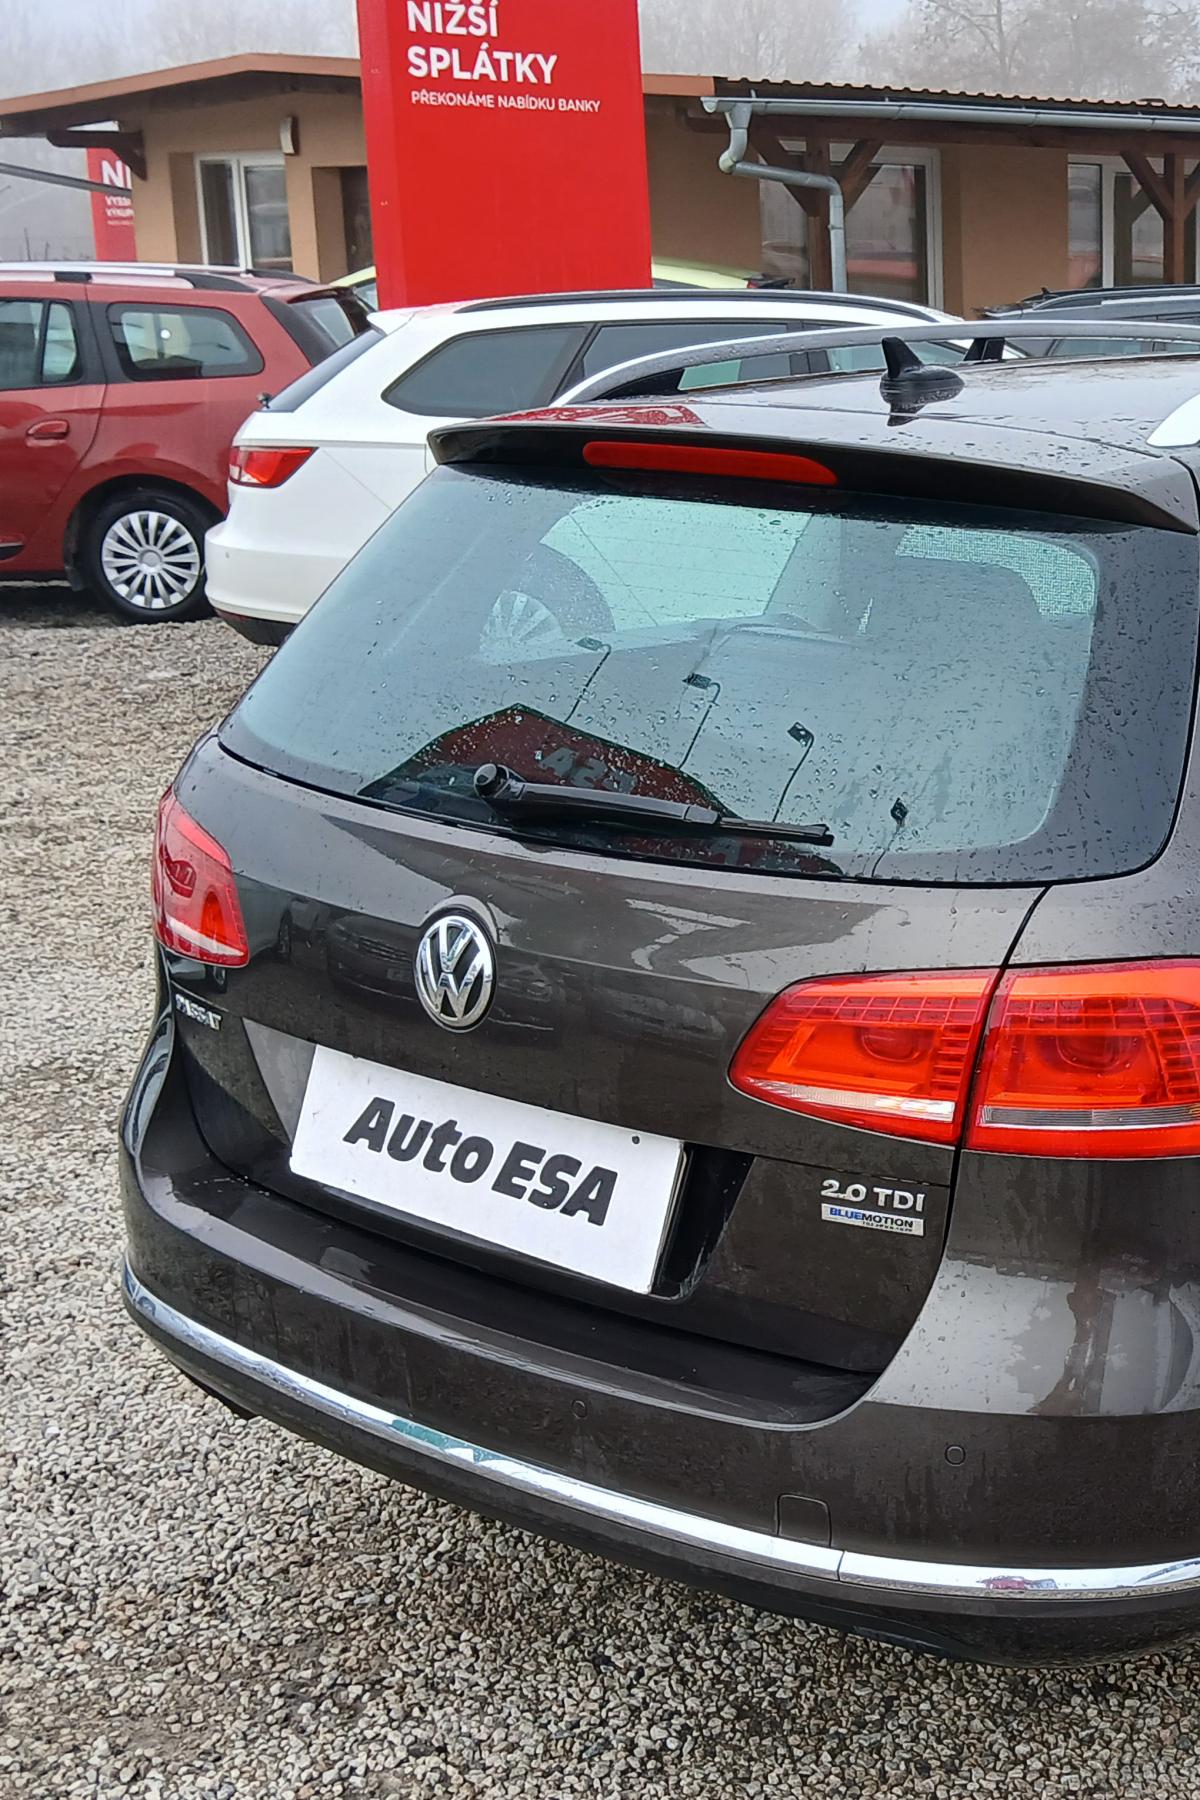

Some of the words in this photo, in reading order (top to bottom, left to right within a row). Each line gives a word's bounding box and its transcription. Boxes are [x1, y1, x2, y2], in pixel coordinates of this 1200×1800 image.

[407, 0, 498, 37] NIŽŠÍ
[407, 42, 558, 85] SPLÁTKY
[411, 88, 495, 108] PŘEKONÁME
[498, 92, 555, 111] NABÍDKU
[558, 98, 600, 113] BANKY
[342, 1096, 495, 1184] Auto
[491, 1140, 619, 1227] ESA
[820, 1179, 868, 1203] 2.0
[872, 1186, 926, 1213] TDI
[828, 1206, 915, 1229] BLUEMOTION
